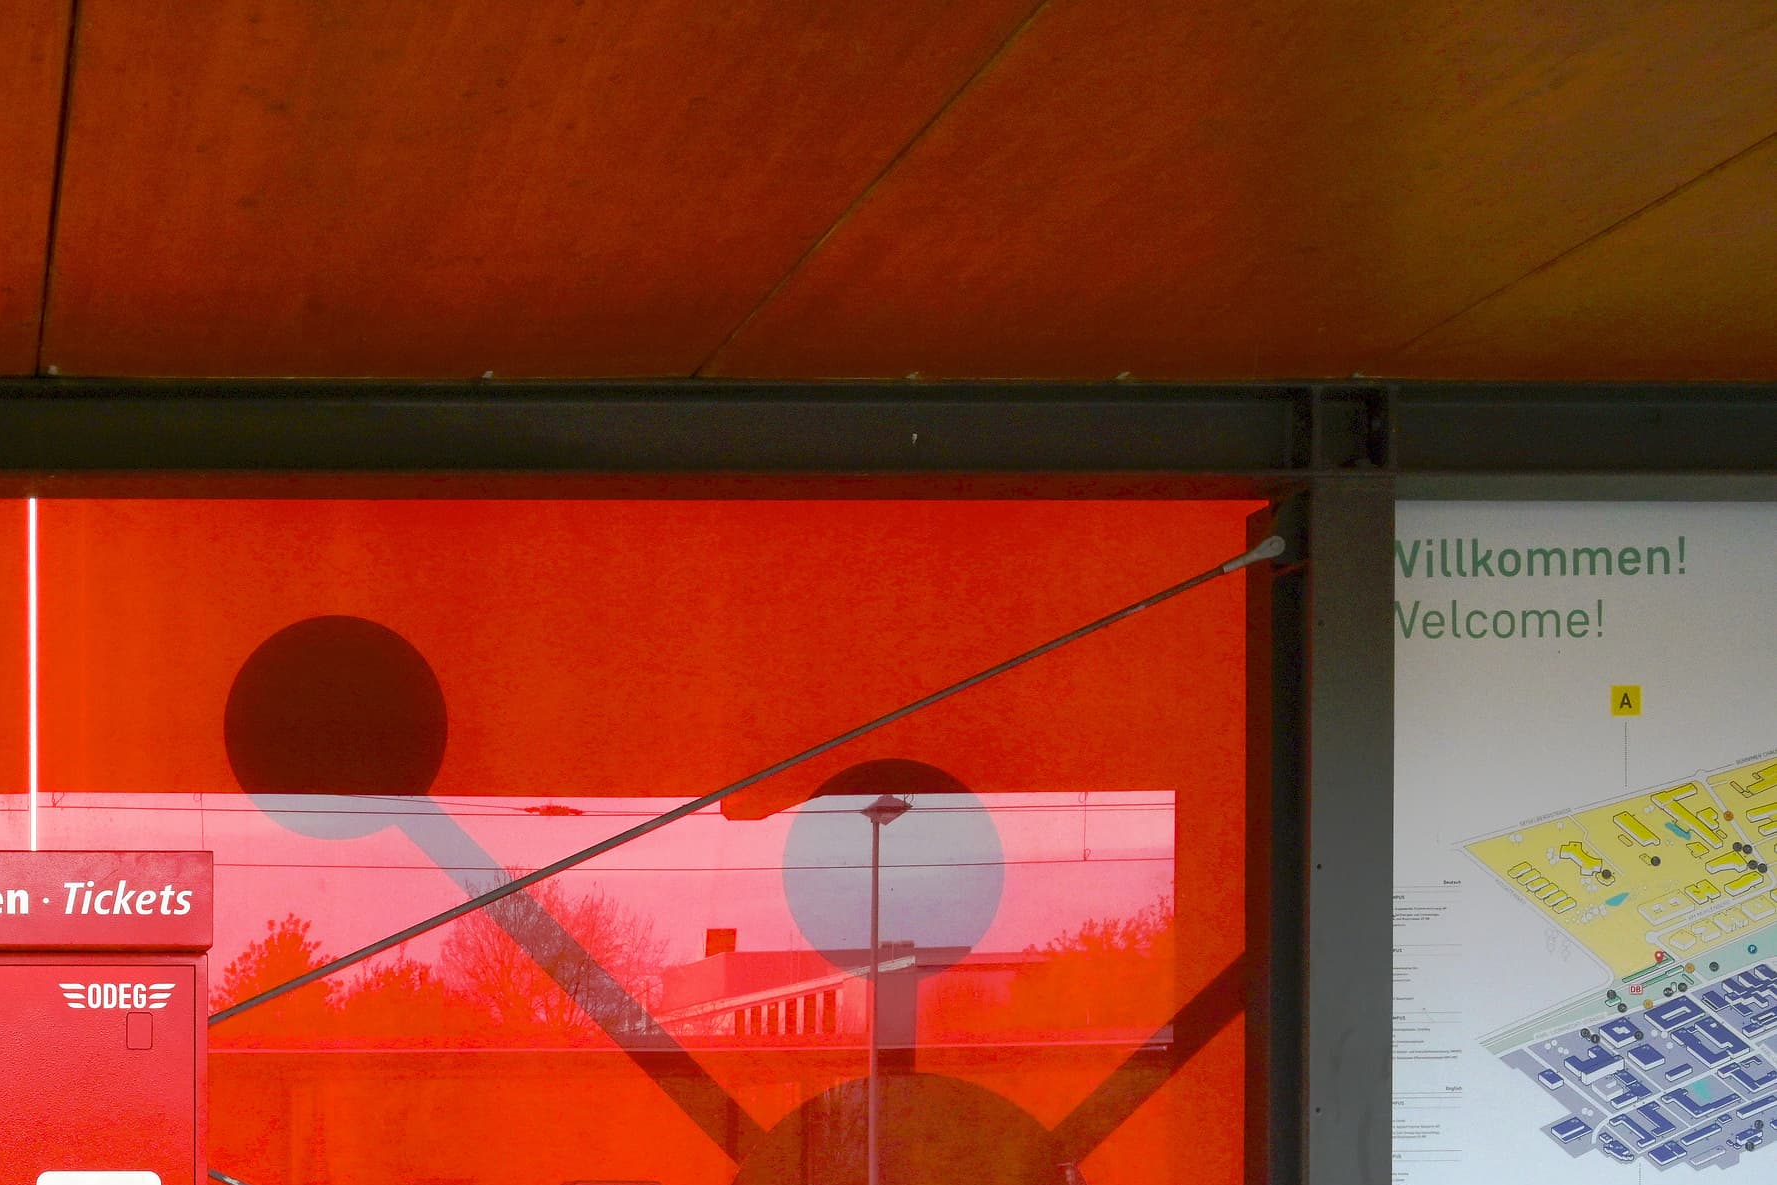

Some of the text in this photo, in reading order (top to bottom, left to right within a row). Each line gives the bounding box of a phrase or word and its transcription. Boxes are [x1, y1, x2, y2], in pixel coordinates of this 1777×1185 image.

[1620, 692, 1632, 709] A
[63, 881, 193, 915] Tickets
[87, 983, 147, 1009] ODEG
